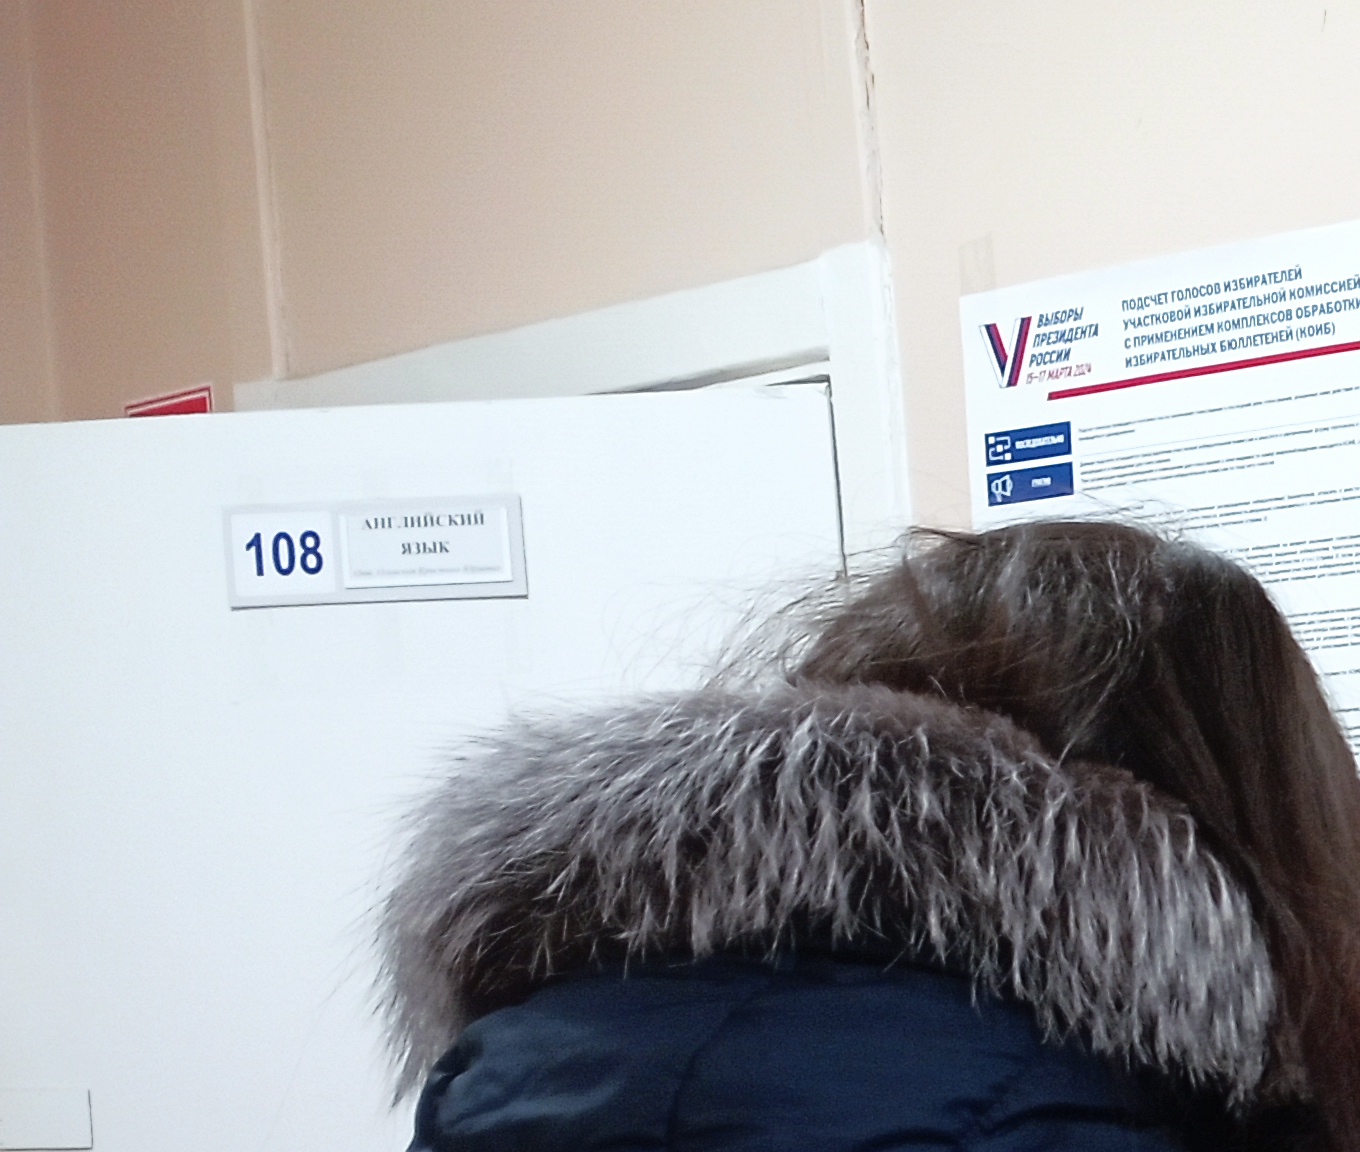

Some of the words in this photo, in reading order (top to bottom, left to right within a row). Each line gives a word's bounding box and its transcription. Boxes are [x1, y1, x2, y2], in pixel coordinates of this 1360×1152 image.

[1120, 291, 1169, 312] ПОДСЧЕТ
[1170, 281, 1222, 303] ГОЛОСОВ
[1222, 266, 1303, 293] ИЗБИРАТЕЛЕЙ
[1036, 306, 1084, 329] ВЫБОРЫ
[1122, 304, 1192, 332] УЧАСТКОВОЙ
[1193, 288, 1287, 319] ИЗБИРАТЕЛЬНОЙ
[1032, 322, 1099, 348] ПРЕЗИДЕНТА
[1123, 336, 1132, 350] С
[1132, 321, 1215, 348] ПРИМЕНЕНИЕМ
[1216, 308, 1293, 334] КОМПЛЕКСОВ
[1028, 346, 1072, 368] РОССИИ
[1124, 341, 1218, 369] ИЗБИРАТЕЛЬНЫХ
[1219, 328, 1294, 353] БЮЛЛЕТЕНЕЙ
[1295, 321, 1336, 342] (КОИБ)
[1046, 365, 1073, 381] МАРТА
[362, 510, 486, 531] АНГЛИЙСКИЙ
[244, 529, 324, 577] 108
[400, 540, 450, 555] ЯЗЫК
